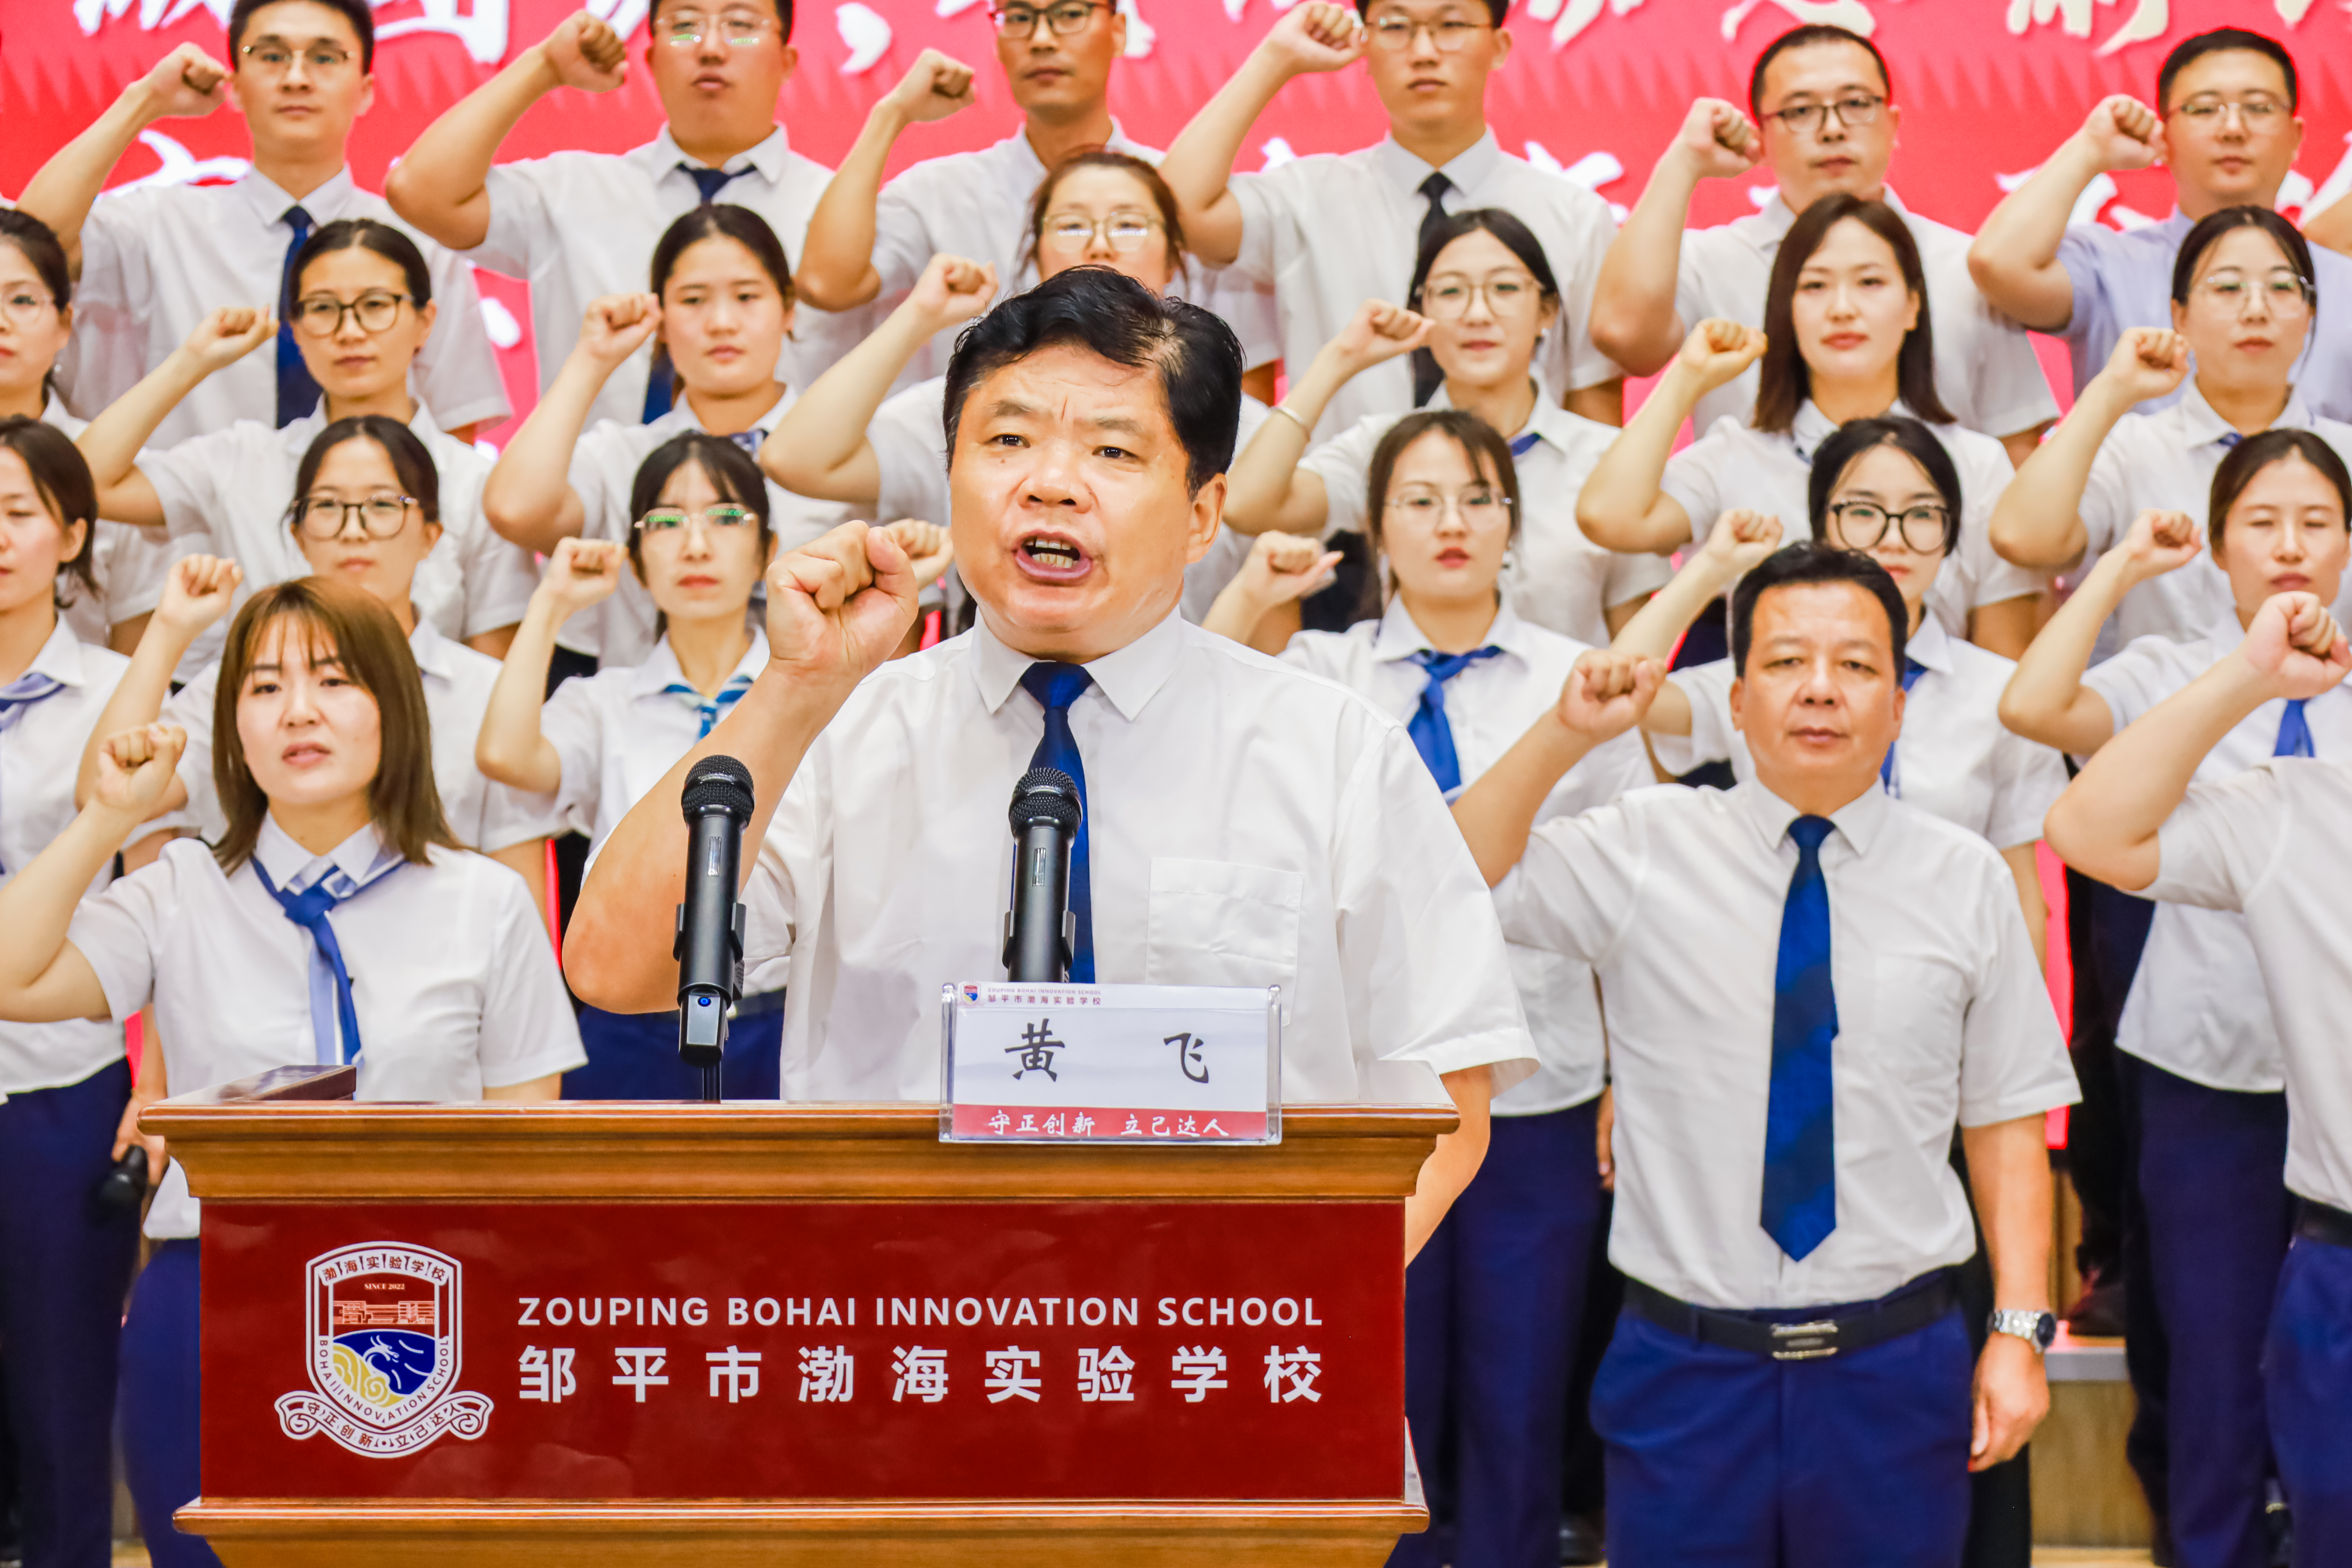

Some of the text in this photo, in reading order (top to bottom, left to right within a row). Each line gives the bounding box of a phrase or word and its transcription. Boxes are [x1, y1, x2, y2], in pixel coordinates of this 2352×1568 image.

[988, 995, 1101, 1005] 邹平市渤海实验学校
[1004, 1018, 1209, 1084] 黄飞
[988, 1109, 1229, 1137] 守正创新 立己达人
[322, 1256, 446, 1281] 渤海实验学校
[518, 1297, 1322, 1326] ZOUPING BOHAI INNOVATION SCHOOL
[427, 1340, 449, 1392] SCHOOL
[518, 1345, 1322, 1403] 邹平市渤海实验学校
